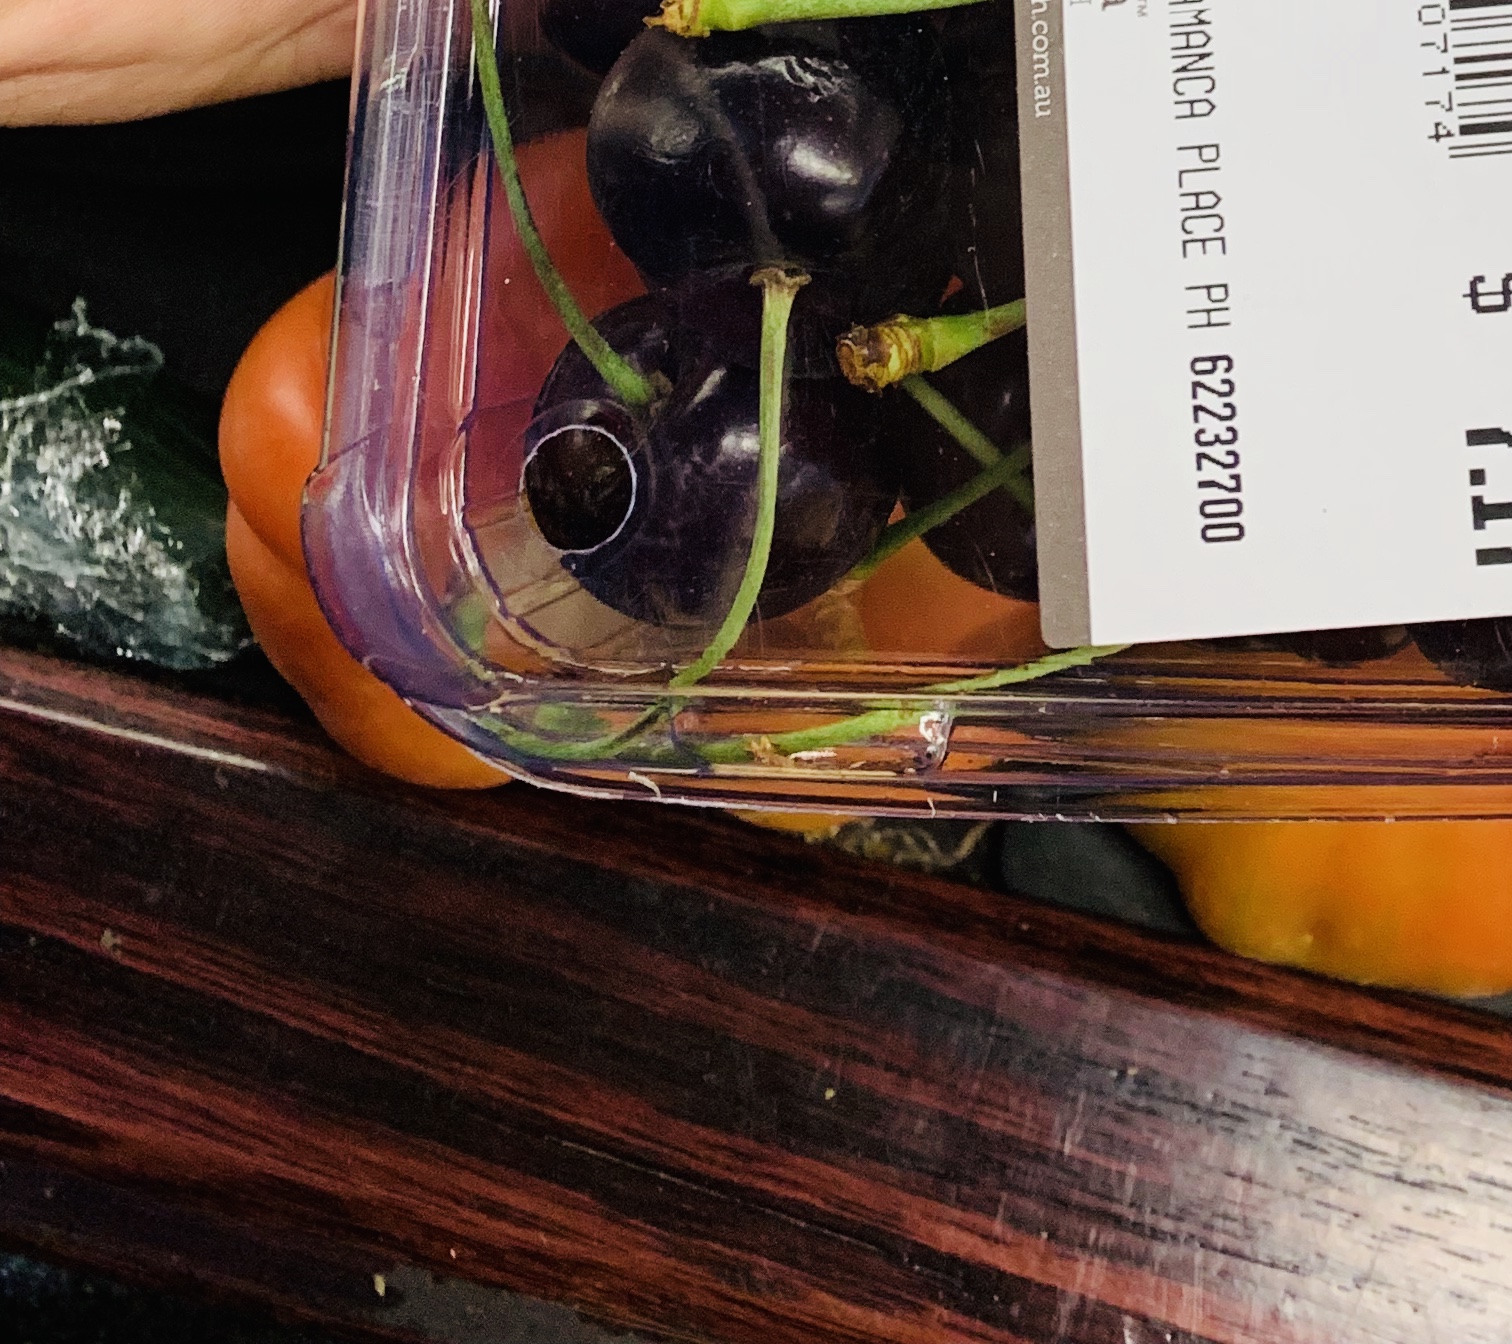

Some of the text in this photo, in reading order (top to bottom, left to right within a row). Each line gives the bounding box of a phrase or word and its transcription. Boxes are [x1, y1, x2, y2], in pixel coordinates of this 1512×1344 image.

[1177, 144, 1226, 258] PLACE
[1185, 283, 1231, 328] PH
[1190, 355, 1245, 543] 62232700
